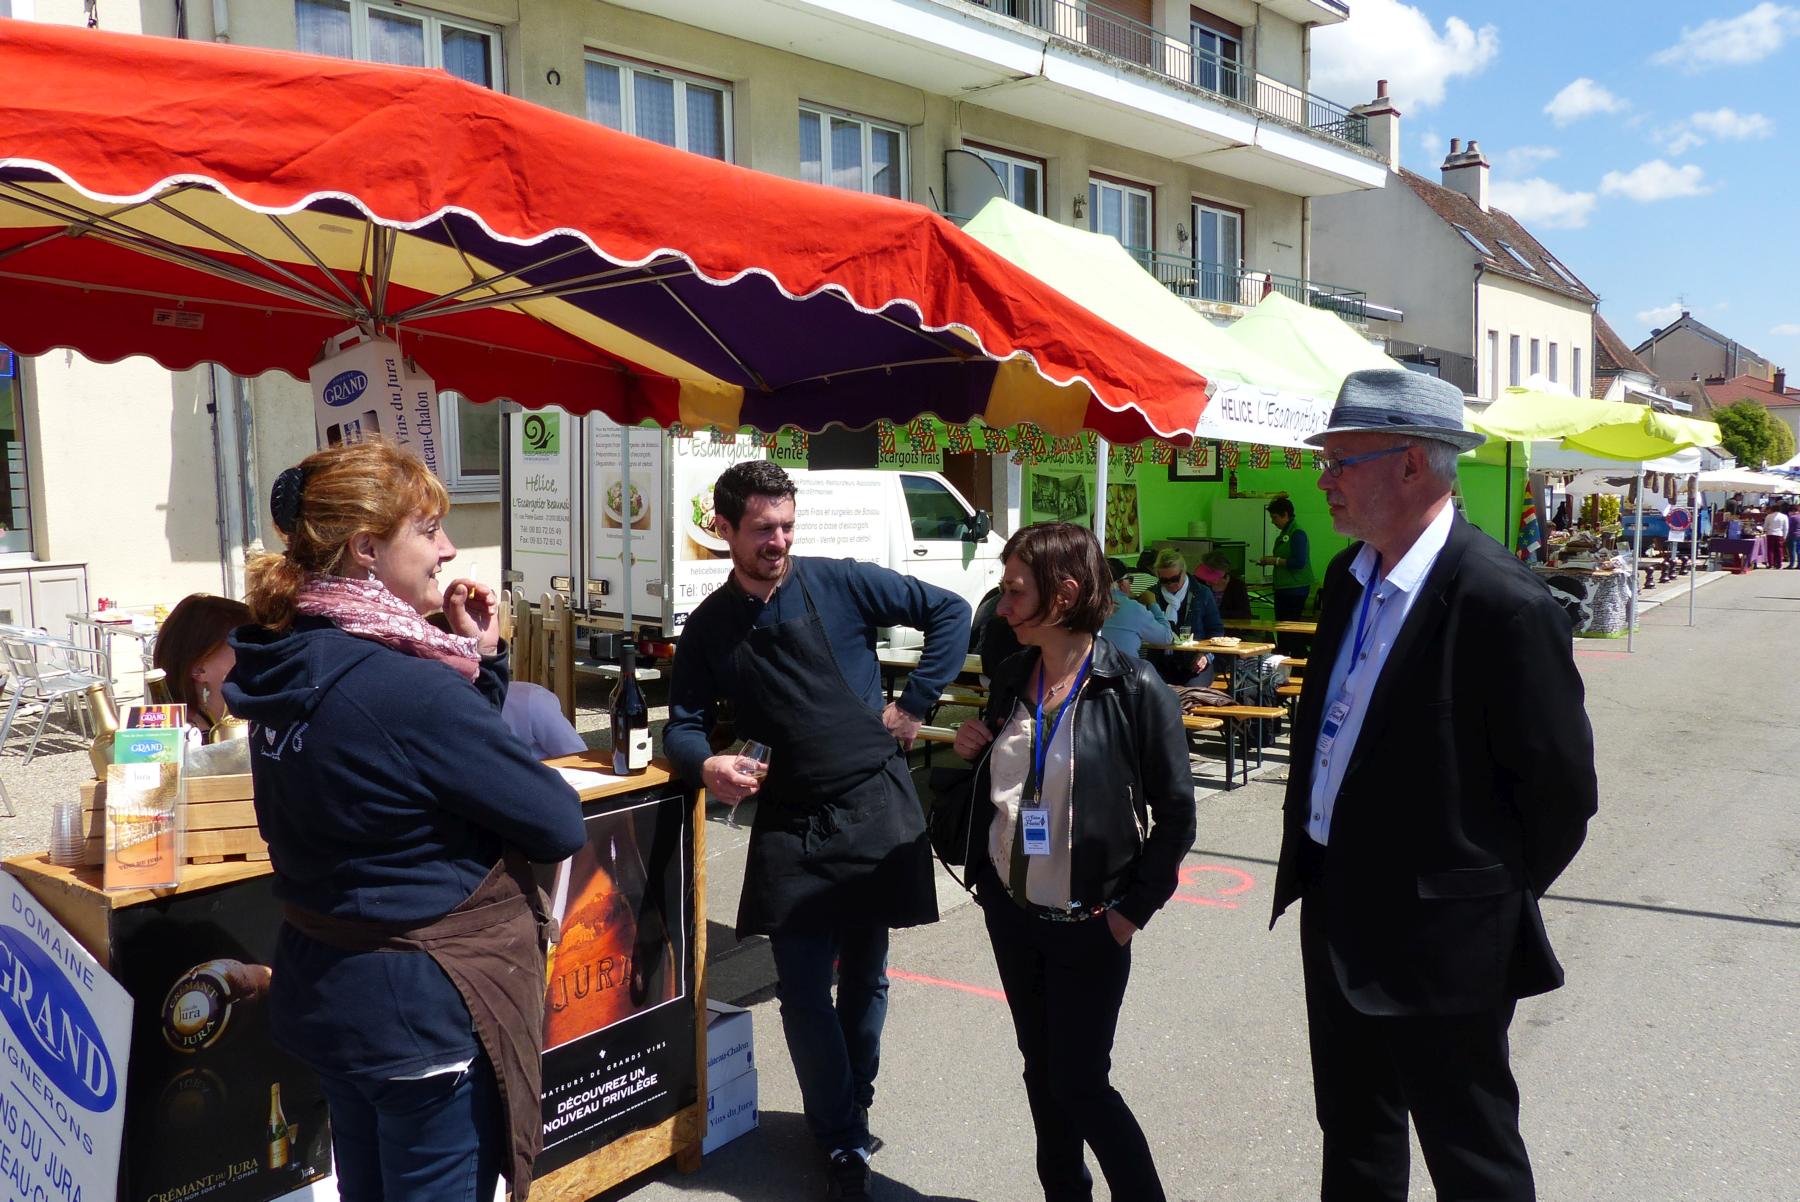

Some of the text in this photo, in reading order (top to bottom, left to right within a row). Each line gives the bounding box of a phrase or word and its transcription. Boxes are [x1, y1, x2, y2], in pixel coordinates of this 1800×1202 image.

[324, 374, 368, 404] GRAND
[384, 358, 403, 391] Jura
[390, 392, 403, 411] du
[1221, 397, 1253, 423] HELICE
[679, 584, 698, 597] Tél:
[130, 743, 163, 753] GRAND
[12, 893, 94, 992] DOMAINE
[183, 1020, 215, 1046] JURA
[590, 1069, 601, 1079] DE
[606, 1052, 641, 1071] GRANDS
[646, 1041, 666, 1054] VINS
[0, 1036, 93, 1156] IGNERONS
[543, 1100, 600, 1135] NOUVEAU
[602, 1073, 658, 1108] PRIVILÈGE
[557, 1066, 646, 1115] DÉCOUVREZ UN
[21, 1118, 42, 1163] DU
[44, 1151, 82, 1202] JURA
[227, 1157, 259, 1179] JURA
